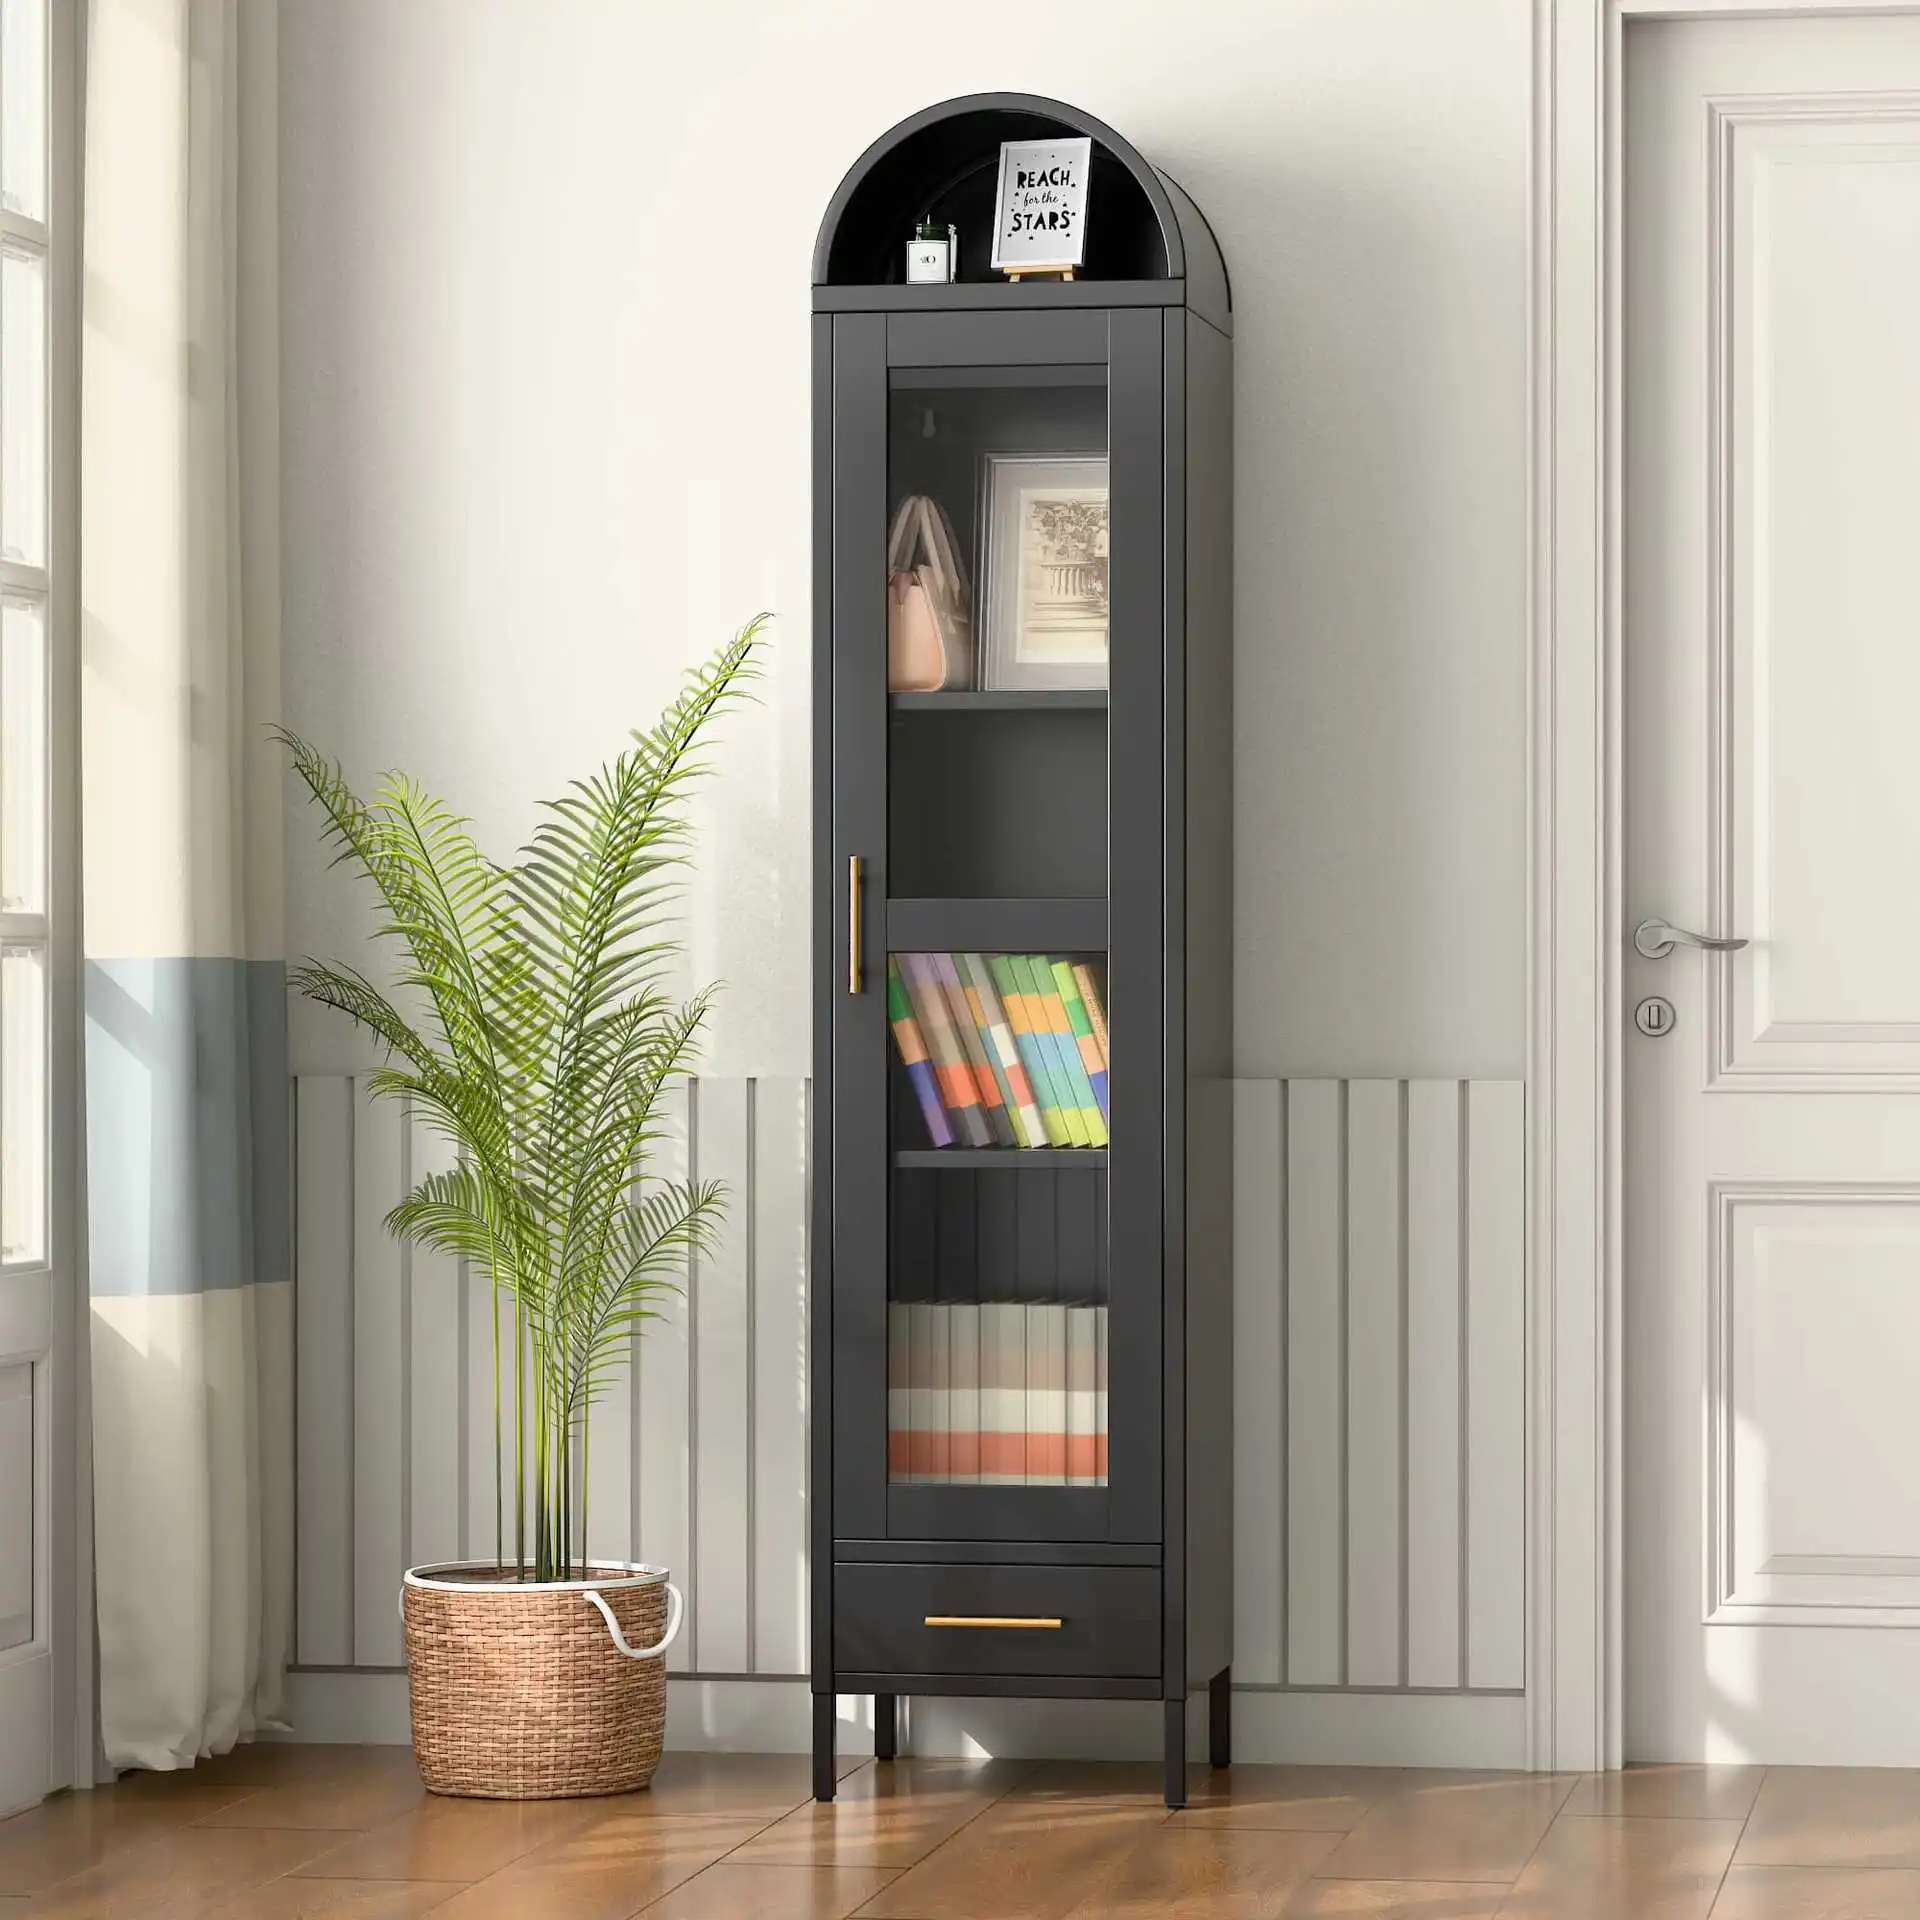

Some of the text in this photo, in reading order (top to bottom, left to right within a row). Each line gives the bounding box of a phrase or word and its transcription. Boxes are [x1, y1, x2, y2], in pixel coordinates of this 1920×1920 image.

[1017, 166, 1070, 189] REACH
[1024, 191, 1058, 207] for the
[1011, 210, 1070, 232] STARS
